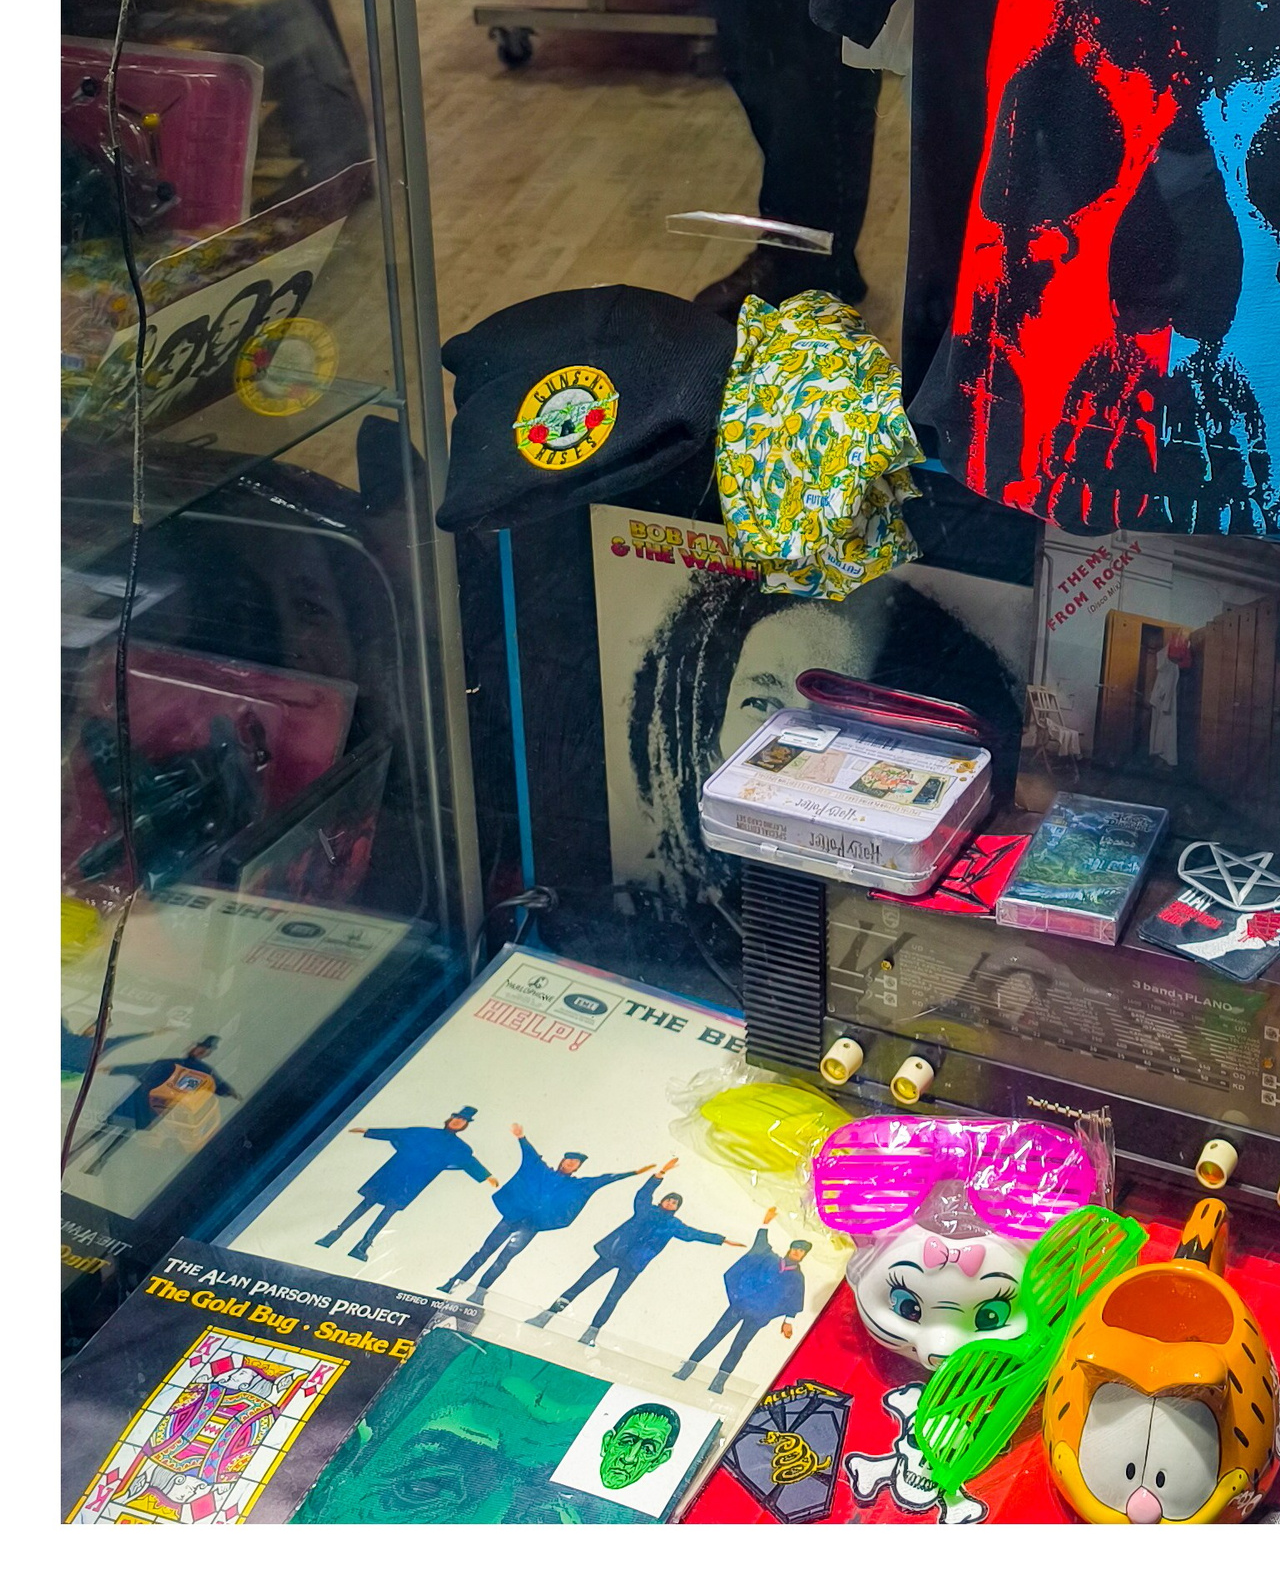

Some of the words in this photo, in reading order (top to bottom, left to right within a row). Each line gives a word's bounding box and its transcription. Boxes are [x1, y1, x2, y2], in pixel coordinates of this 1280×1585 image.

[533, 370, 582, 404] GUNS
[534, 435, 597, 465] ROSES
[629, 518, 683, 547] BOB
[685, 529, 730, 558] MA
[631, 538, 675, 564] THE
[1046, 590, 1090, 632] FROM
[1092, 540, 1142, 591] ROCKY
[1057, 545, 1112, 595] THEME
[1087, 595, 1109, 615] (Disco
[1106, 580, 1122, 599] Mix)
[806, 831, 846, 860] Potter
[845, 838, 883, 865] Harry
[1132, 979, 1141, 989] 3
[1184, 993, 1234, 1013] PLANO
[473, 998, 593, 1052] HELP!
[623, 999, 689, 1033] THE
[697, 1025, 748, 1054] BE
[163, 1257, 203, 1278] THE
[199, 1267, 252, 1290] ALAN
[249, 1278, 331, 1310] PARSONS
[329, 1298, 411, 1328] PROJECT
[395, 1291, 429, 1306] STEREO
[144, 1274, 188, 1302] The
[190, 1290, 253, 1321] Gold
[246, 1305, 300, 1335] Bug
[313, 1320, 391, 1365] Snake
[193, 1334, 215, 1358] K
[307, 1363, 337, 1388] K
